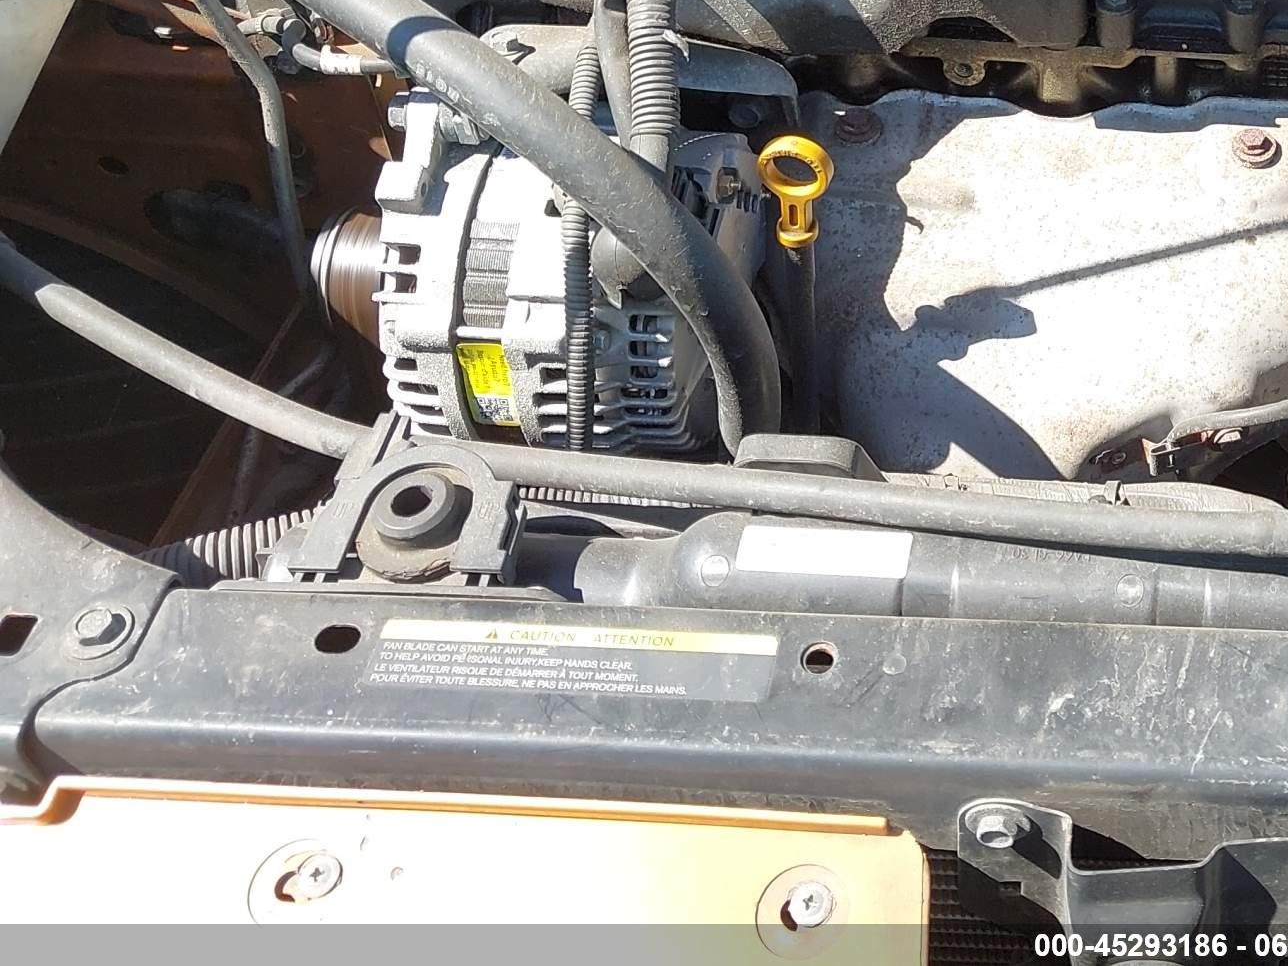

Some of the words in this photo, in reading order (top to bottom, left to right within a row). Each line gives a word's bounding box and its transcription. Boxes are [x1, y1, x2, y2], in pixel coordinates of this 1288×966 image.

[510, 629, 577, 643] CAUTION
[593, 633, 675, 647] ATTENTION
[383, 641, 403, 651] FAN
[404, 642, 435, 652] BLADE
[436, 643, 458, 653] CAN
[460, 644, 489, 654] START
[490, 645, 503, 654] AT
[504, 645, 525, 655] ANY
[380, 652, 392, 661] TO
[393, 652, 420, 662] HELP
[421, 653, 451, 663] AVOID
[564, 659, 598, 669] HANDS
[374, 663, 388, 672] LE
[388, 664, 449, 674] VENTILATEUR
[451, 666, 488, 677] RISQUE
[489, 668, 503, 677] DE
[504, 667, 558, 679] DÉMARRER
[558, 668, 567, 679] À
[568, 670, 593, 680] TOUT
[370, 673, 399, 683] POUR
[400, 673, 433, 684] ÉVITER
[435, 675, 465, 685] TOUTE
[521, 678, 536, 688] NE
[537, 680, 557, 690] PAS
[558, 681, 571, 691] EN
[572, 681, 634, 693] APPROCHER
[634, 684, 653, 694] LES
